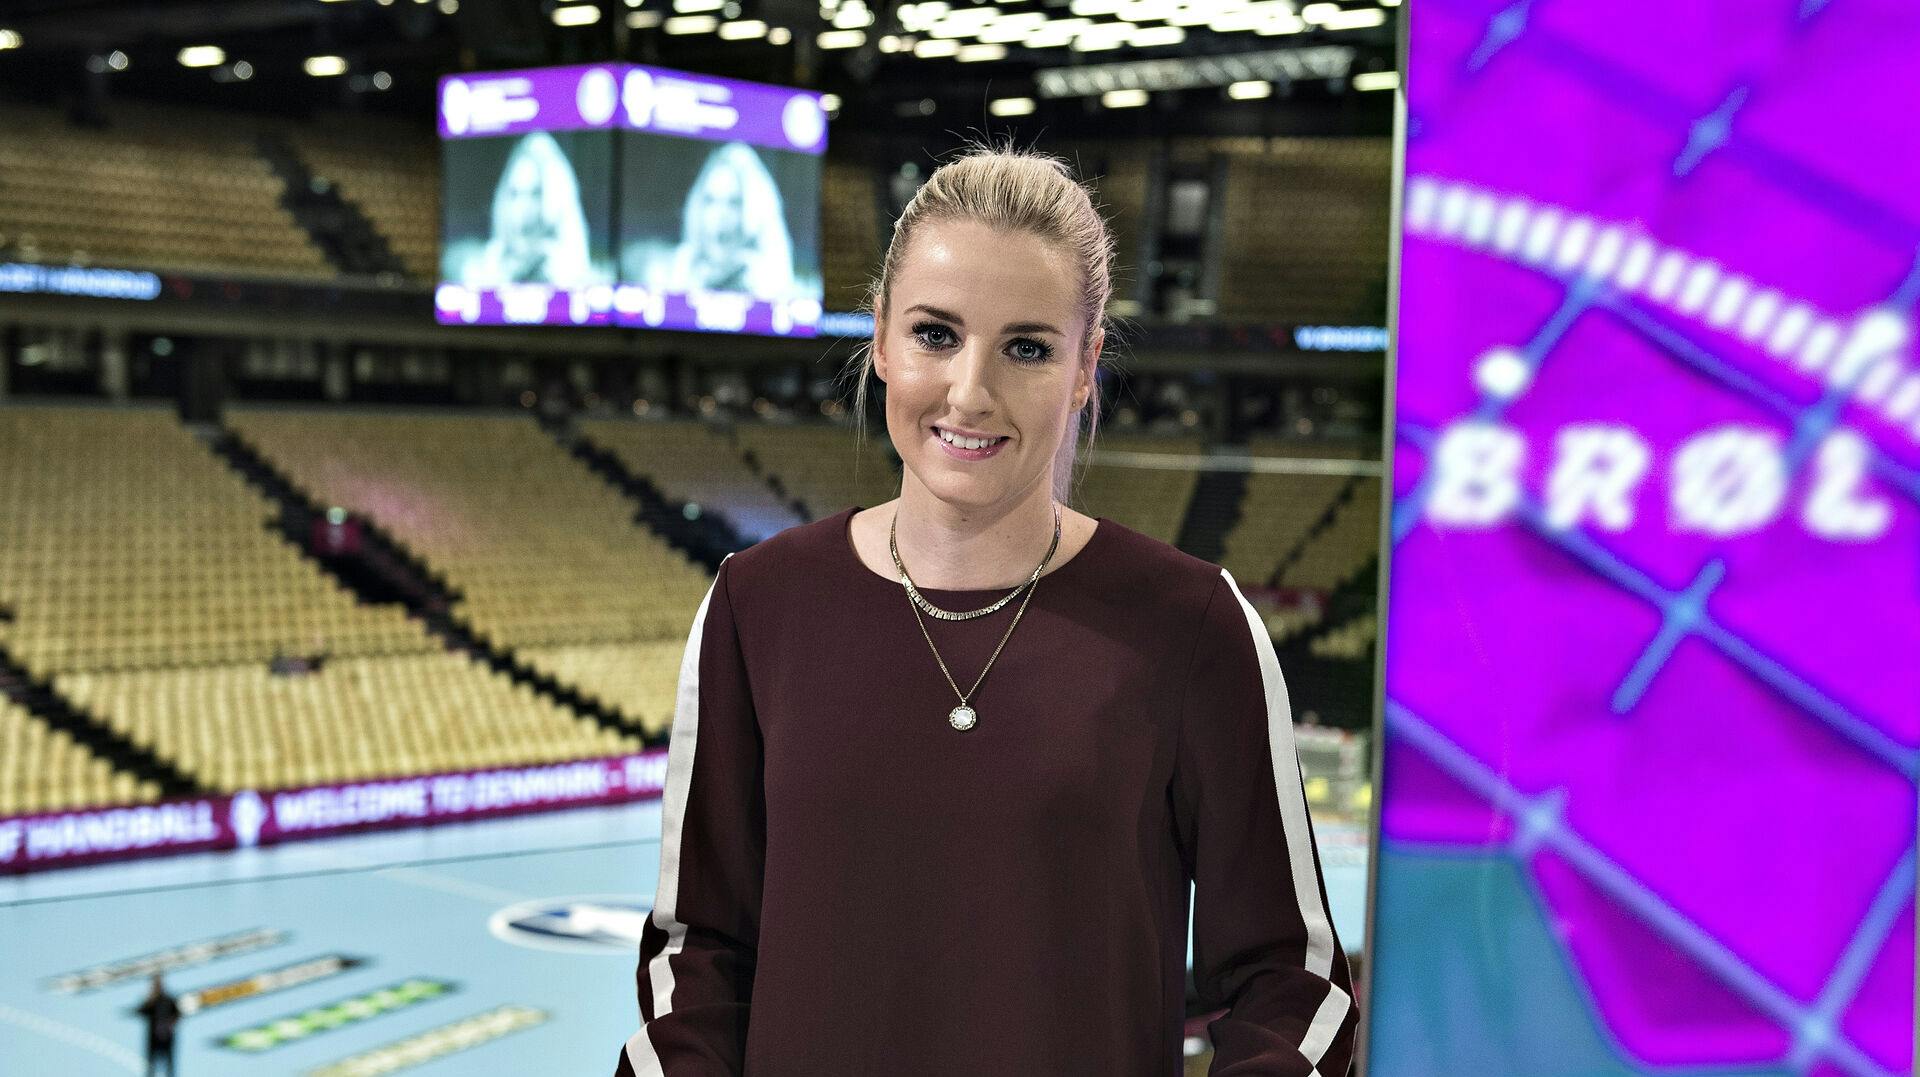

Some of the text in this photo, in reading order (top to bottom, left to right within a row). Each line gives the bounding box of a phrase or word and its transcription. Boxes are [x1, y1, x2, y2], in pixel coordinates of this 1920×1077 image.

[1427, 423, 1890, 537] BRØL
[26, 801, 219, 858] HANDBALL
[274, 778, 424, 830] WELCOME
[431, 772, 469, 813] TO
[470, 757, 608, 810] DENMARK
